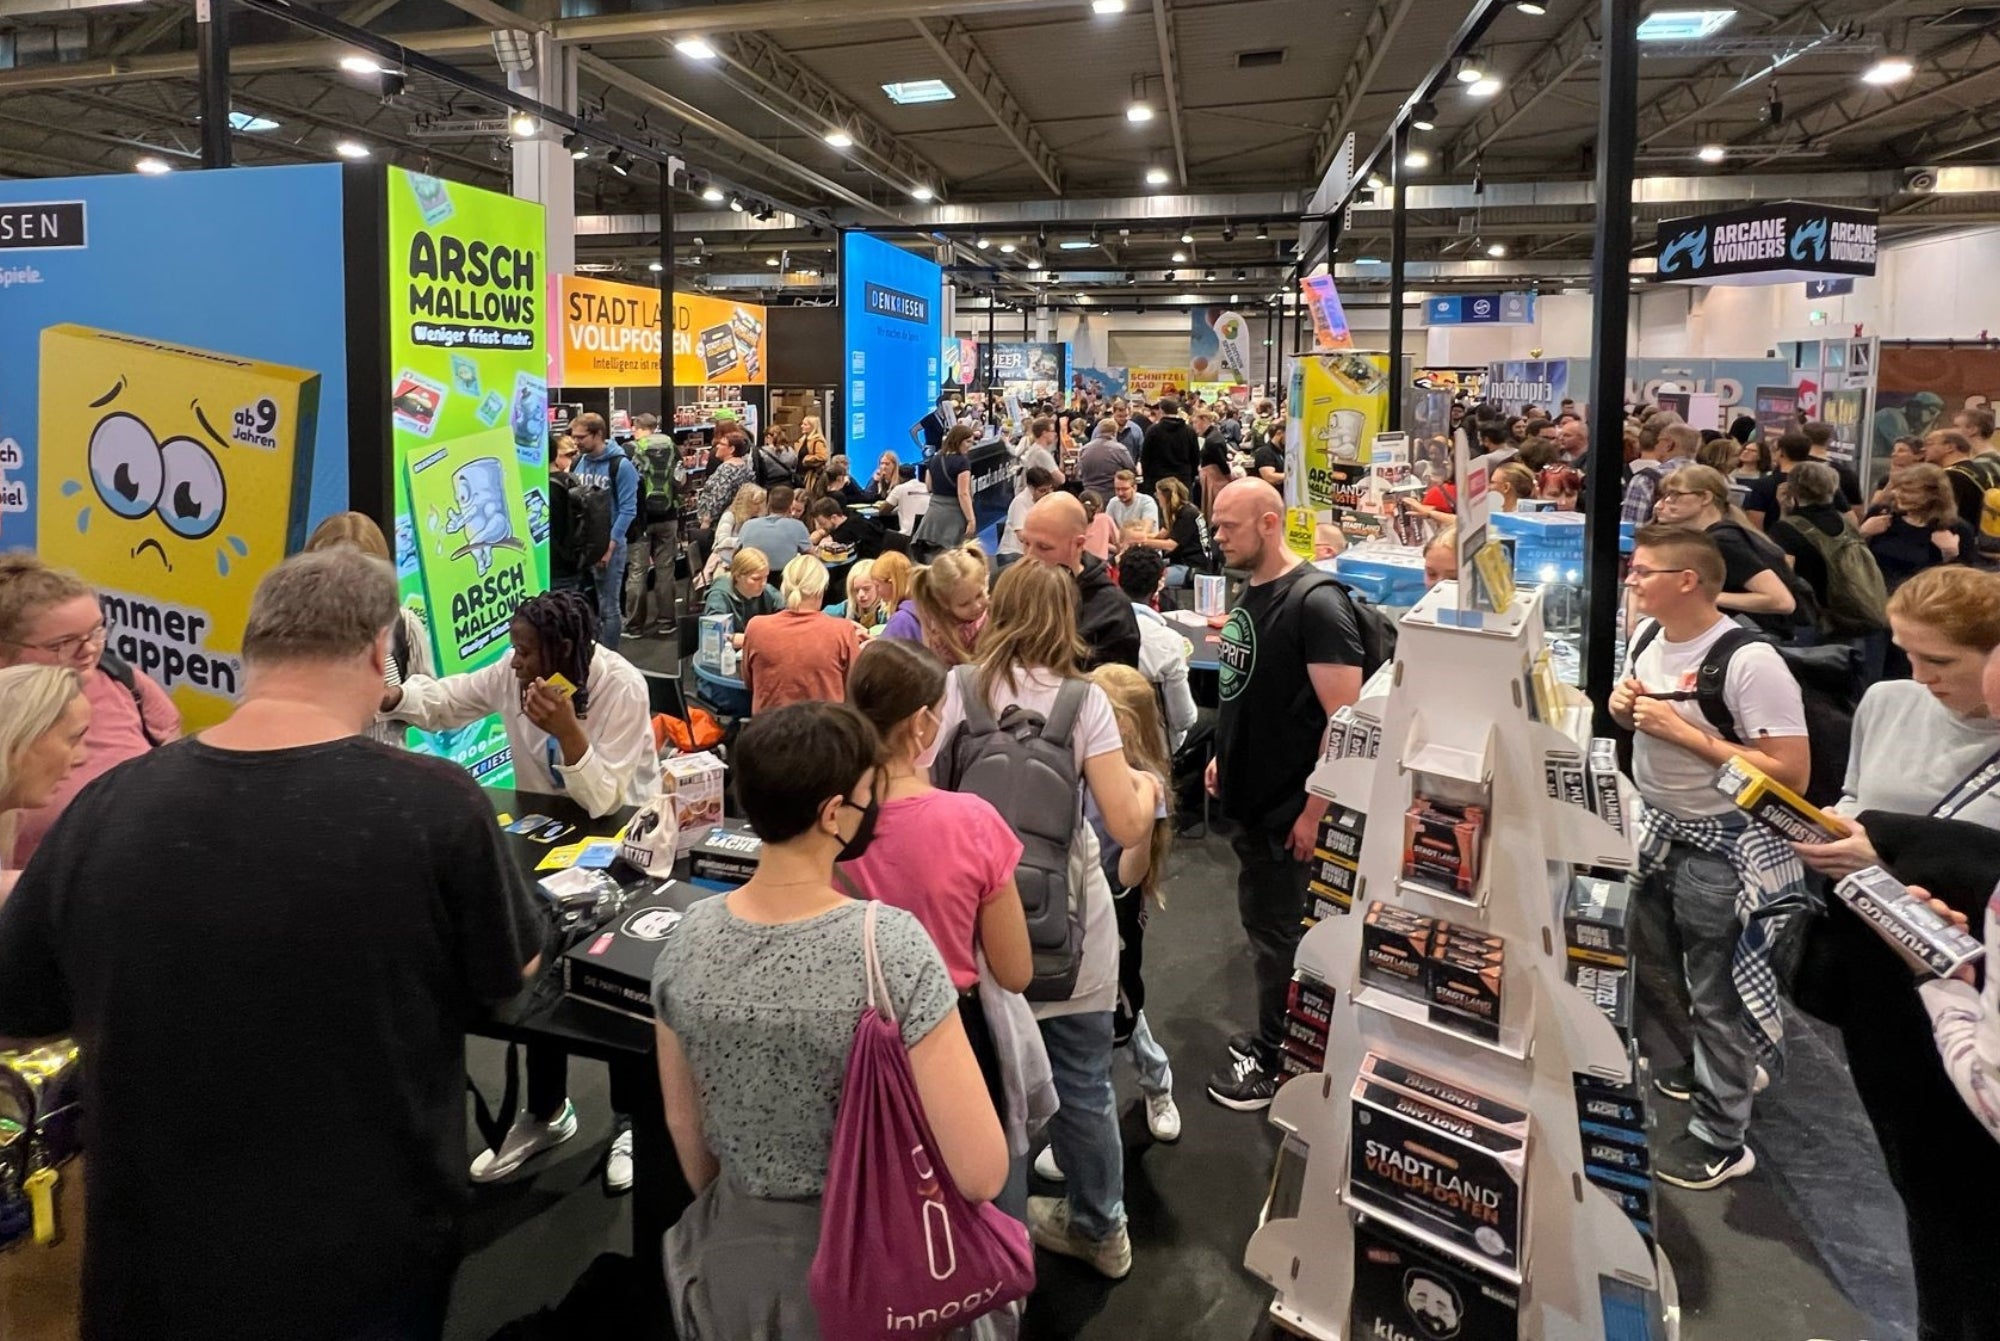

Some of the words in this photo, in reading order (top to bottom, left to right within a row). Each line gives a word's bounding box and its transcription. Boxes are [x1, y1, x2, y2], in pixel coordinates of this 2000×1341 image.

[0, 213, 59, 240] SEN
[1714, 218, 1787, 245] ARCANE
[1831, 222, 1877, 243] ARCANE
[409, 231, 534, 292] ARSCH
[1713, 239, 1786, 264] WONDERS
[1830, 241, 1877, 264] WONDERS
[409, 283, 535, 324] MALLOWS
[570, 292, 639, 327] STADT
[643, 301, 690, 331] LAD
[872, 290, 924, 319] DENKRIESEN
[414, 326, 466, 347] Weniger
[468, 328, 500, 345] frisst
[502, 332, 533, 346] mehr.
[569, 323, 692, 355] VOLLPFOSEN
[593, 356, 639, 372] Intelligenz
[1131, 372, 1185, 382] SCHNITZEL
[1131, 381, 1155, 390] JAGD
[234, 408, 255, 428] ab
[256, 399, 277, 434] 9
[232, 426, 276, 449] Jahren
[0, 445, 18, 463] ch
[1308, 467, 1333, 483] ARS
[0, 486, 23, 506] iel
[452, 561, 525, 623] ARSCH
[100, 593, 206, 645] mmer
[454, 588, 527, 644] MALLOWS
[116, 632, 236, 693] appen
[1219, 640, 1250, 670] PRIT
[471, 749, 513, 778] KRIESE
[1439, 1087, 1479, 1110] STADT
[1434, 1116, 1474, 1139] STADT
[1364, 1139, 1435, 1181] STADT
[1435, 1169, 1499, 1209] LAND
[1364, 1155, 1499, 1226] VOLLPFOSTEN
